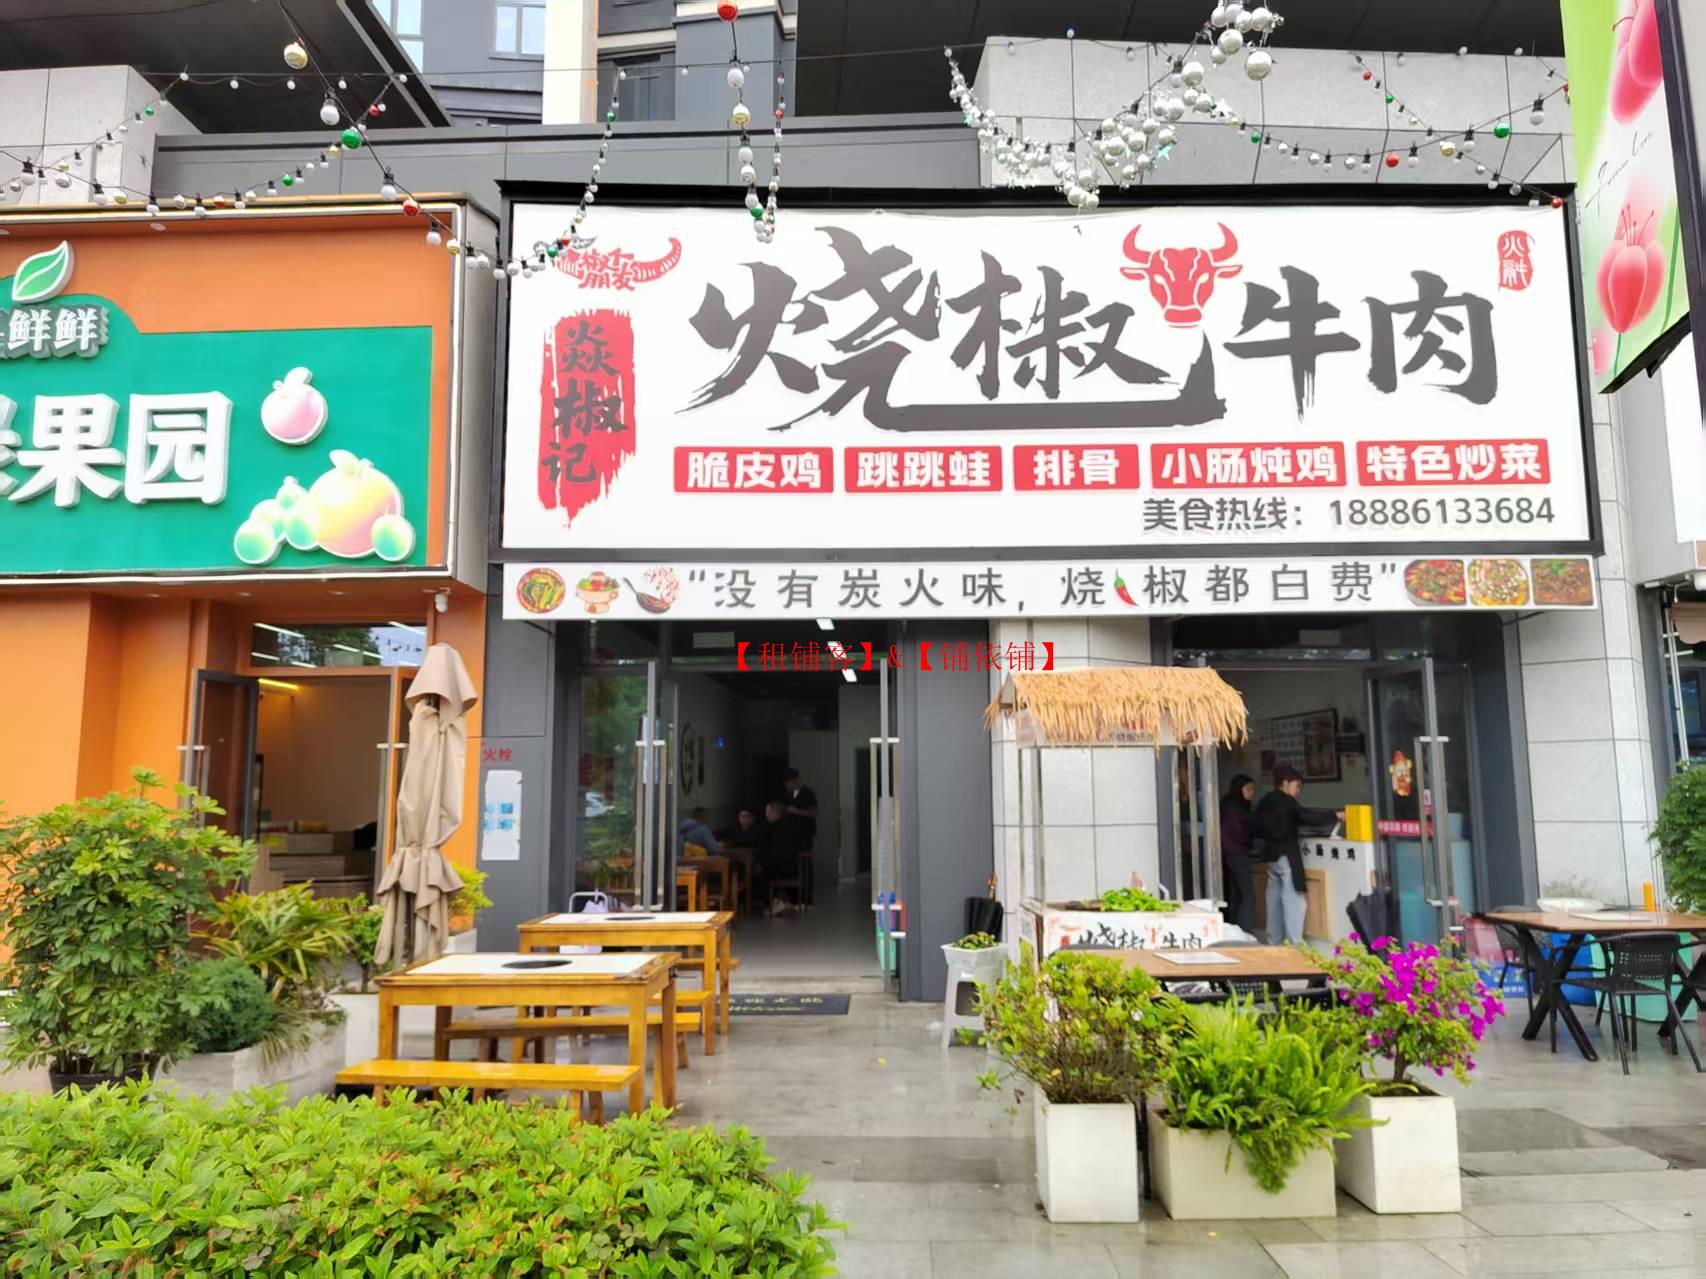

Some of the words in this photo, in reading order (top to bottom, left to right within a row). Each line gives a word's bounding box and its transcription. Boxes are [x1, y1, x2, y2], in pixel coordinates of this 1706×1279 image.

[0, 308, 99, 352] 鲜鲜
[674, 227, 1500, 434] 烧椒牛肉
[0, 392, 232, 507] 果园
[541, 320, 628, 483] 焱椒记
[687, 452, 821, 489] 脆皮鸡
[857, 452, 992, 489] 跳跳蛙
[1033, 450, 1120, 487] 排骨
[1160, 448, 1338, 484] 小肠炖鸡
[1366, 444, 1543, 482] 特色炒菜
